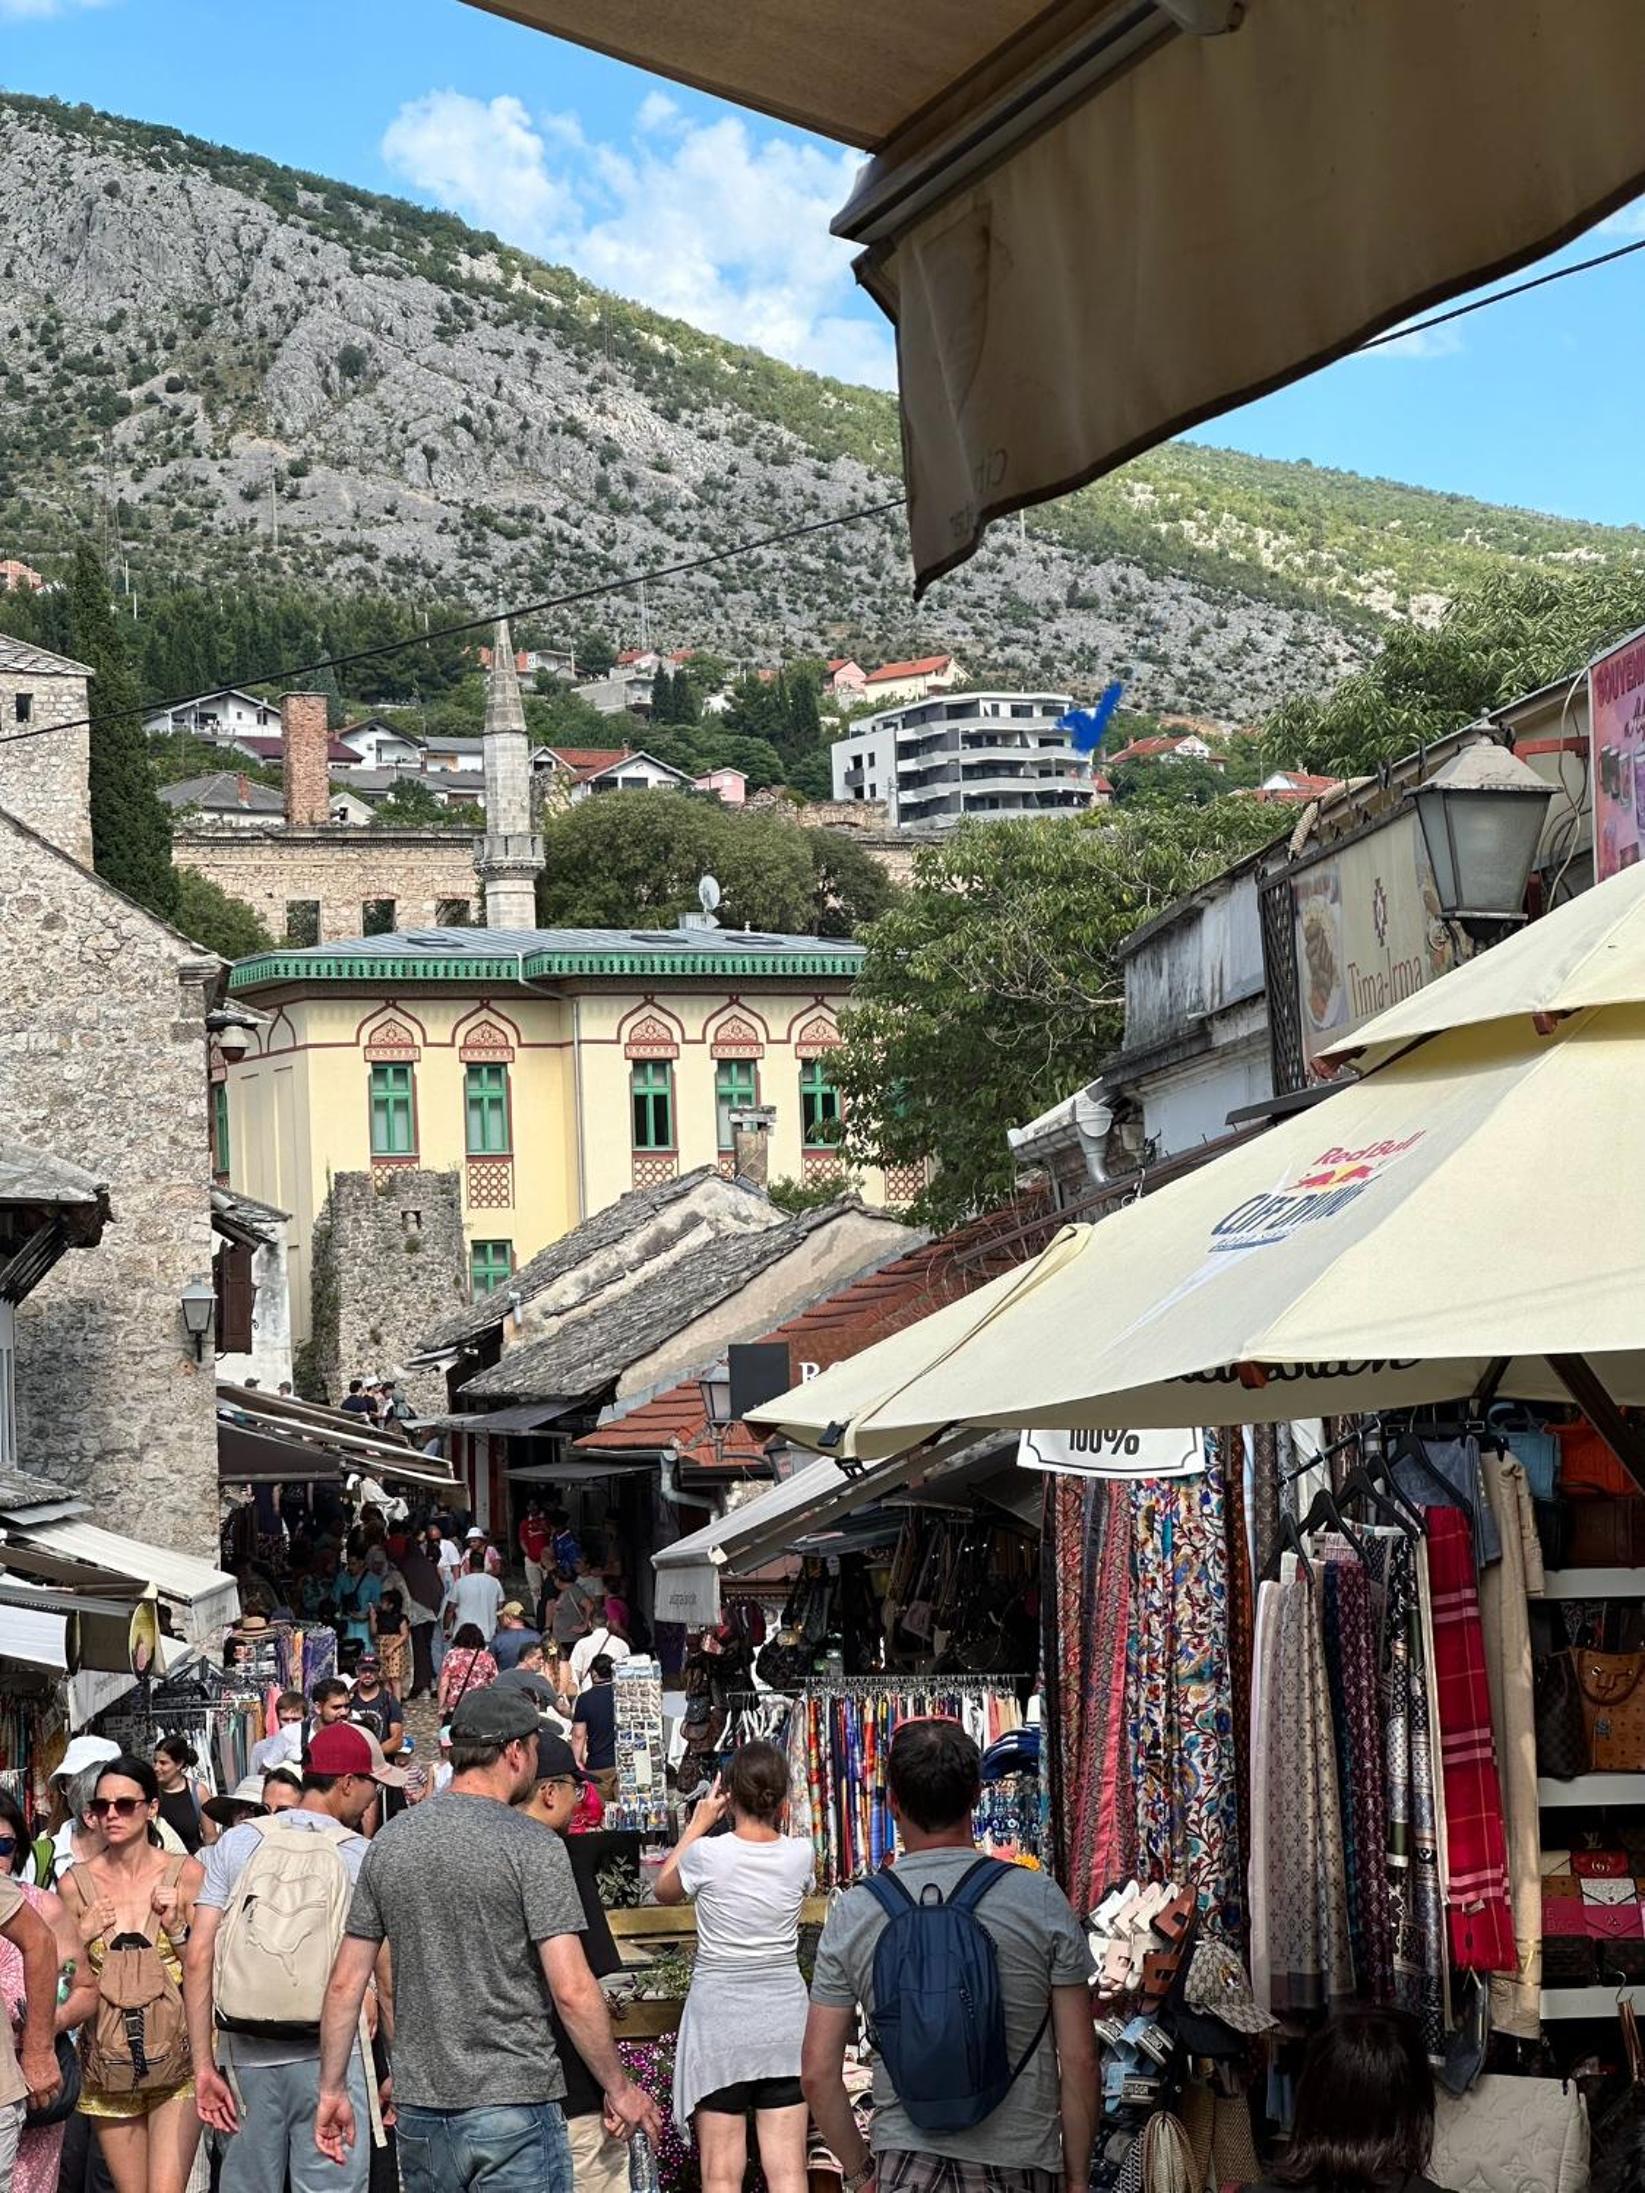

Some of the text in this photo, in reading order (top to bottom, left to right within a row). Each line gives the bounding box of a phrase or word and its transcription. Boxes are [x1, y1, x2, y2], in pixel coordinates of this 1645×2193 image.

[1347, 946, 1423, 1018] Tima-Irma
[1312, 1130, 1426, 1165] Red Bull
